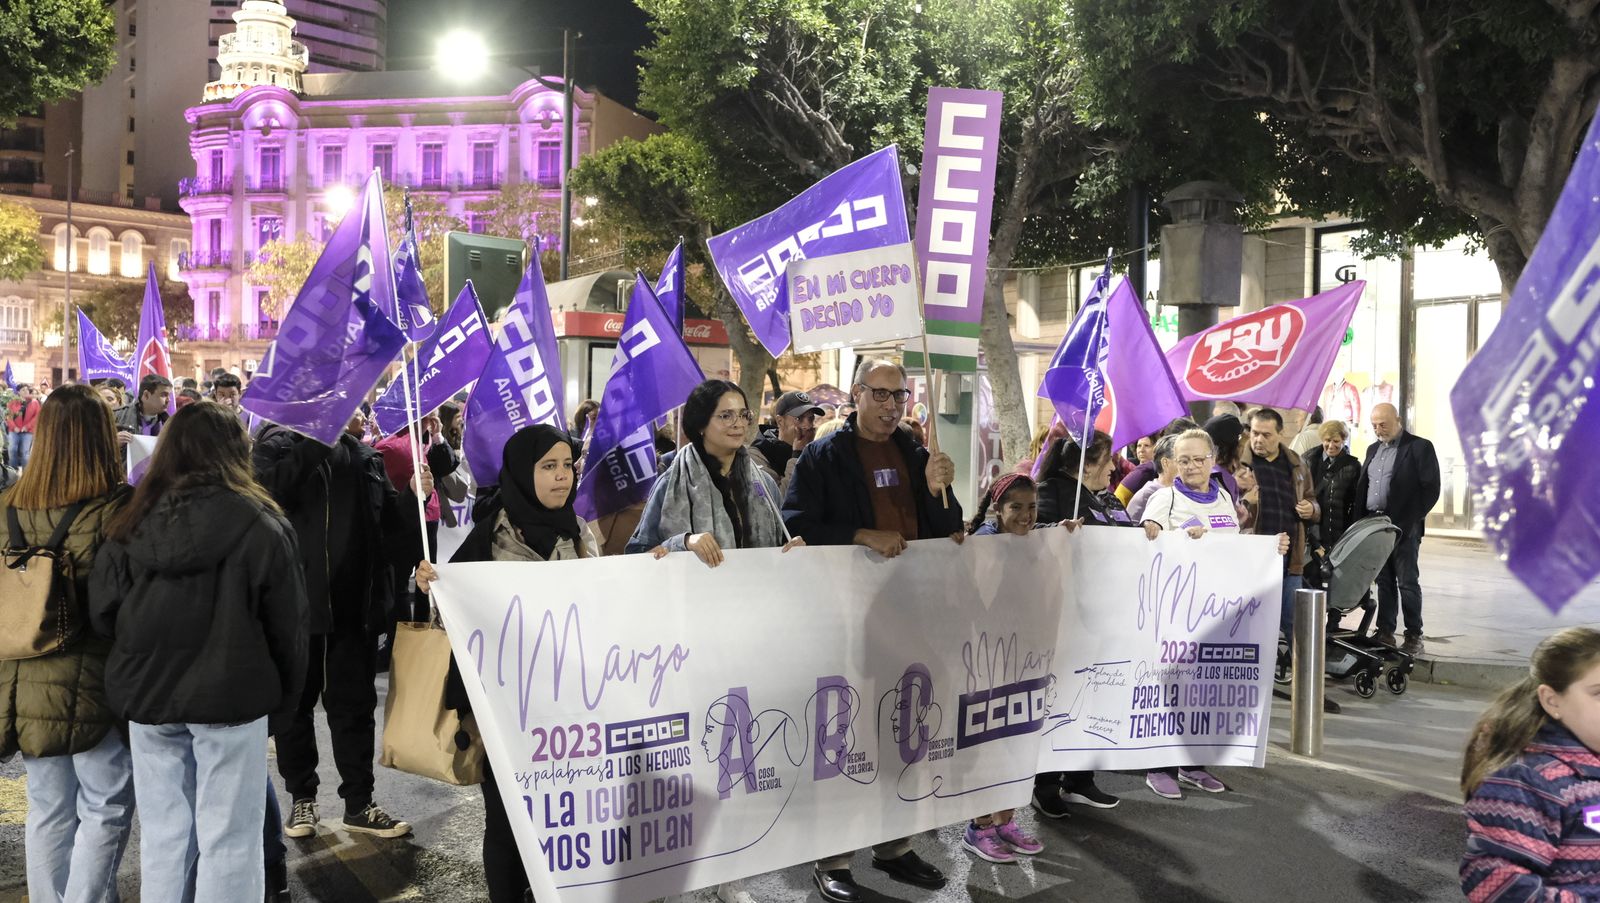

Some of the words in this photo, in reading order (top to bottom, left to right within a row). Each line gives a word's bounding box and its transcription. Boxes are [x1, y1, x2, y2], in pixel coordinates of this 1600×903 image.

[924, 101, 987, 308] CCOO
[793, 275, 821, 304] EN
[850, 264, 912, 290] CUERPO
[868, 293, 895, 318] YO
[1137, 572, 1146, 632] 8
[1148, 552, 1262, 642] Marzo
[497, 595, 690, 732] Marzo
[961, 640, 977, 697] 8
[1160, 640, 1198, 664] 2023
[1201, 646, 1244, 660] CCOO
[1205, 666, 1221, 680] LOS
[1223, 666, 1260, 680] HECHOS
[531, 722, 602, 763] 2023
[610, 720, 672, 748] CCOO
[1129, 711, 1185, 739] TENEMOS
[1190, 712, 1210, 736] UN
[618, 754, 641, 777] LOS
[646, 746, 691, 773] HECHOS
[758, 766, 775, 780] COSO
[601, 825, 632, 866] UN
